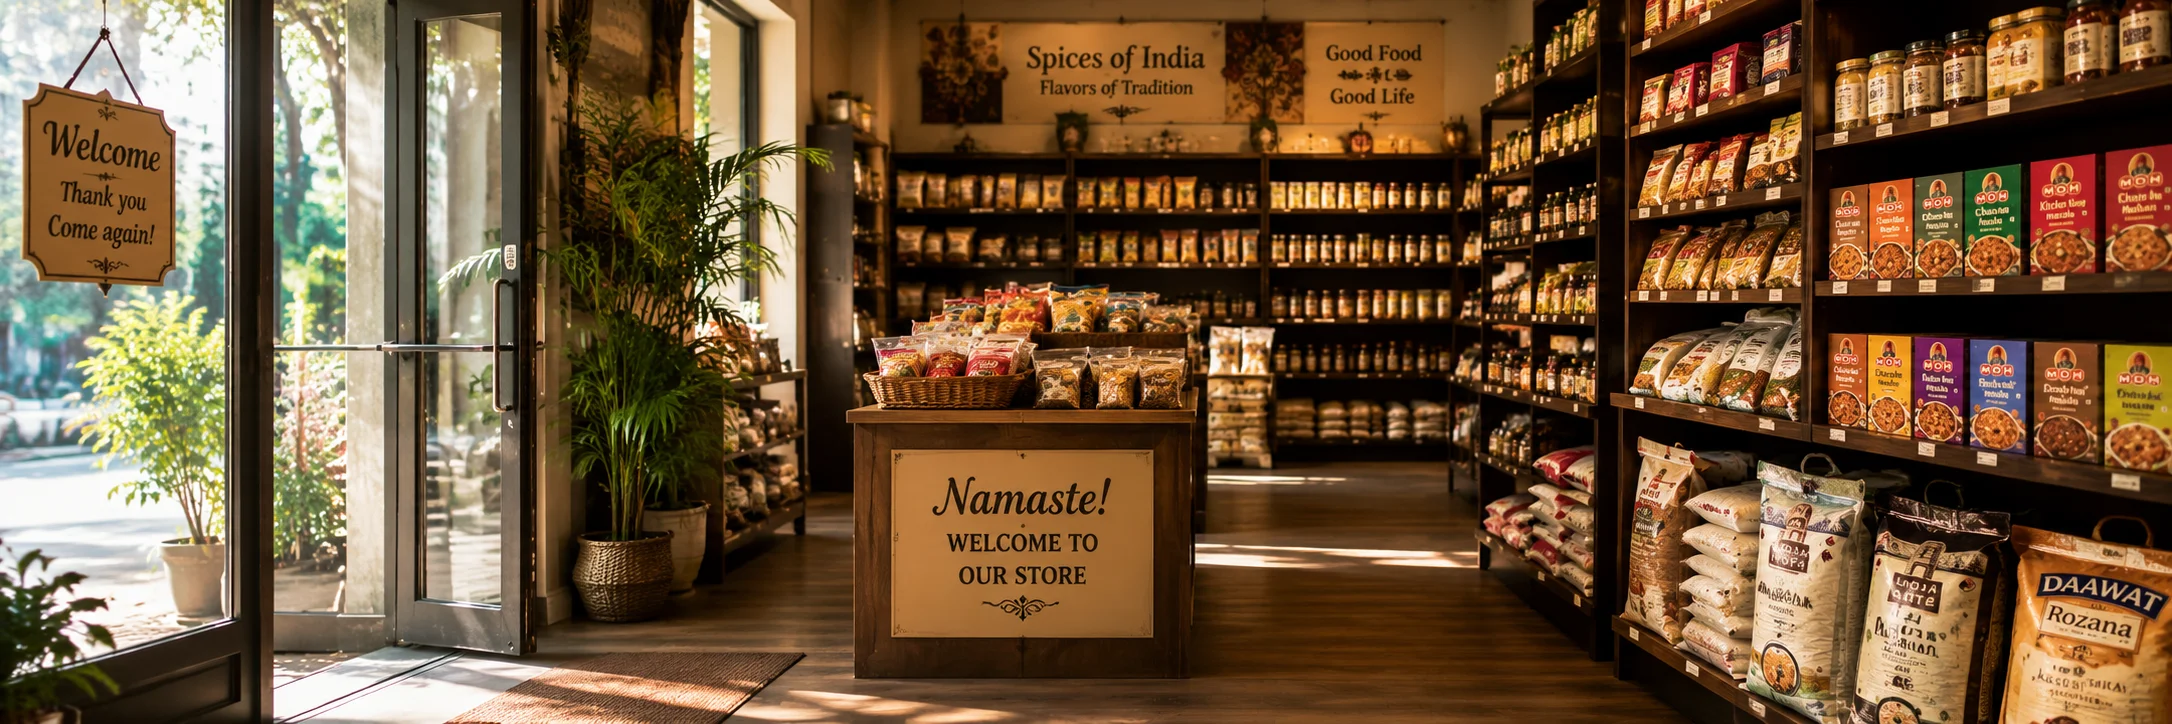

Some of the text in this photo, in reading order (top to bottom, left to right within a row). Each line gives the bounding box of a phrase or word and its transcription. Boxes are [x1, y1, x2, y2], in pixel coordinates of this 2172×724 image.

[1026, 45, 1205, 75] Spices of India
[1325, 44, 1422, 62] Good Food
[1040, 79, 1194, 99] Flavors of Tradition
[1330, 88, 1415, 106] Good Life
[43, 120, 161, 172] Welcome
[61, 181, 147, 215] Thank you
[48, 214, 155, 249] Come again!
[932, 476, 1111, 516] Namaste!
[947, 533, 1098, 552] WELCOME TO
[958, 566, 1087, 585] OUR STORE
[2042, 575, 2163, 612] DAAWAT
[2047, 604, 2132, 638] Rozana
